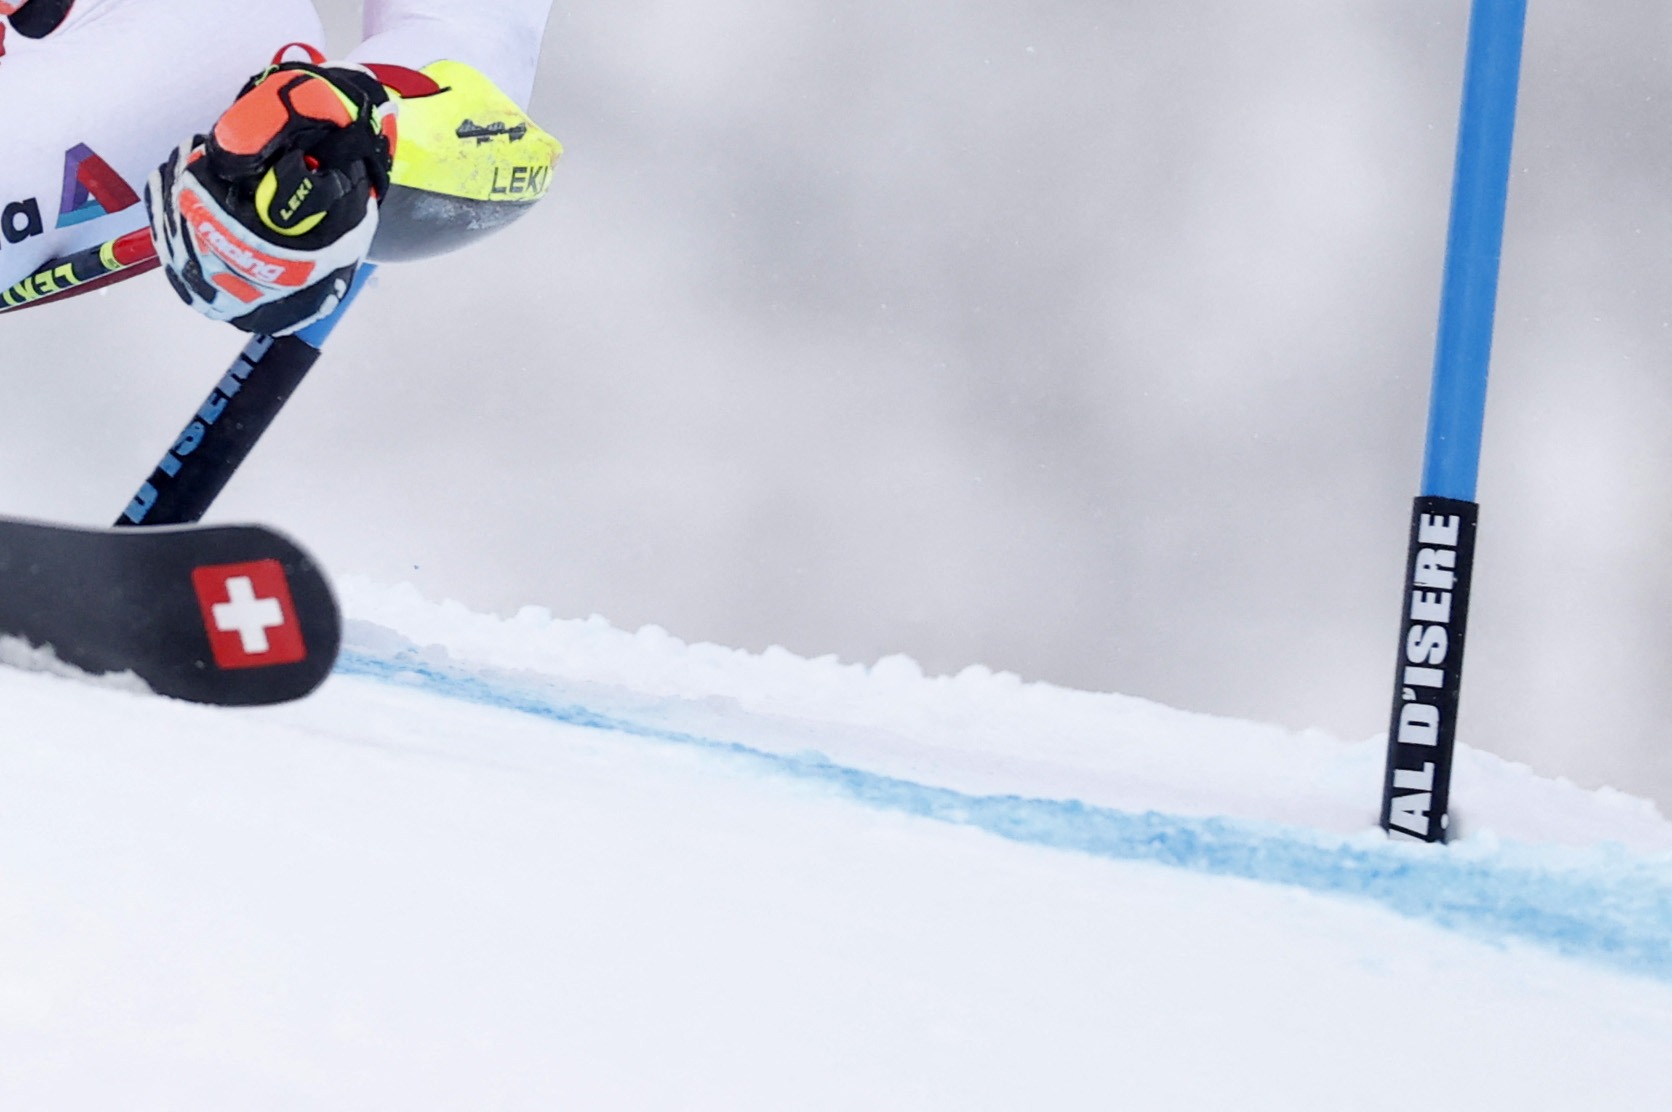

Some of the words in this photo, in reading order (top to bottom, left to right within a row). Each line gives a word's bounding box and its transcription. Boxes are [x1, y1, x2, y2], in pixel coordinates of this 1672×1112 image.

[279, 177, 314, 221] LEKI
[490, 165, 549, 194] LEKI
[2, 262, 82, 307] LEKI
[1397, 512, 1461, 747] D'ISERE
